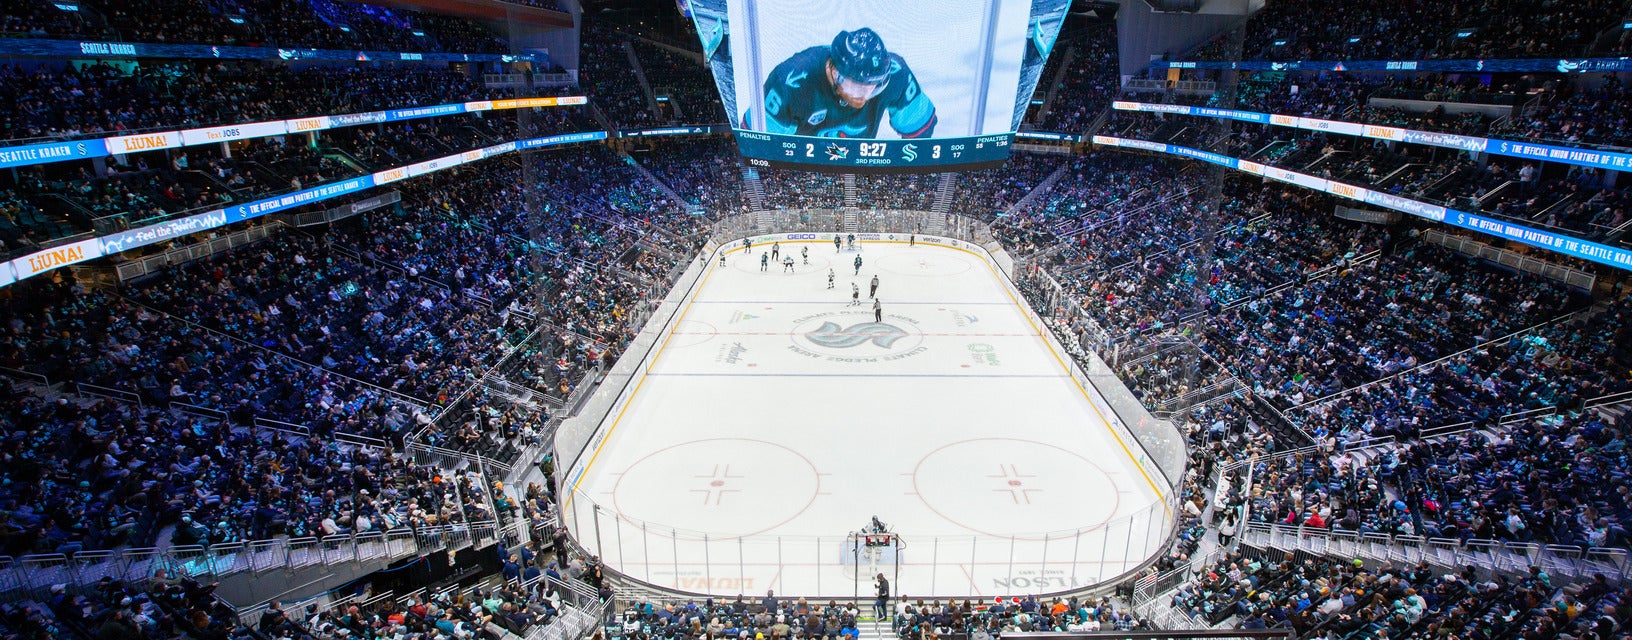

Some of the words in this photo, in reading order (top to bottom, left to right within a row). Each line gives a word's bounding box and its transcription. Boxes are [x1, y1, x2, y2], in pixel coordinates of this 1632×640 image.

[766, 88, 783, 115] 6
[206, 131, 222, 140] Text
[223, 128, 240, 138] JOBS
[740, 132, 771, 141] PENALTIES
[977, 135, 1008, 143] PENALTIES
[124, 135, 168, 151] LiUNA!
[806, 144, 815, 157] 2
[860, 142, 886, 157] 9:27
[0, 150, 37, 163] SEATTLE
[38, 146, 71, 159] KRAKEN
[932, 145, 941, 158] 3
[1512, 145, 1522, 153] THE
[1524, 146, 1548, 157] OFFICIAL
[1550, 148, 1569, 159] UNION
[1569, 150, 1599, 163] PARTNER
[1601, 155, 1610, 165] OF
[1612, 156, 1625, 167] THE
[250, 204, 260, 214] THE
[260, 200, 281, 211] OFFICIAL
[281, 196, 295, 206] UNION
[295, 191, 314, 202] PARTNER
[328, 184, 344, 194] SEATTLE
[344, 181, 358, 190] KRAKEN
[136, 229, 157, 242] Feel
[157, 227, 171, 237] the
[168, 219, 196, 235] Power
[1468, 217, 1478, 228] THE
[1479, 220, 1503, 234] OFFICIAL
[1505, 226, 1523, 238] UNION
[1524, 230, 1554, 246] PARTNER
[1554, 236, 1564, 247] OF
[1566, 240, 1578, 252] THE
[1580, 243, 1612, 260] SEATTLE
[29, 245, 84, 273] LiUNA!
[993, 576, 1097, 588] FILSON
